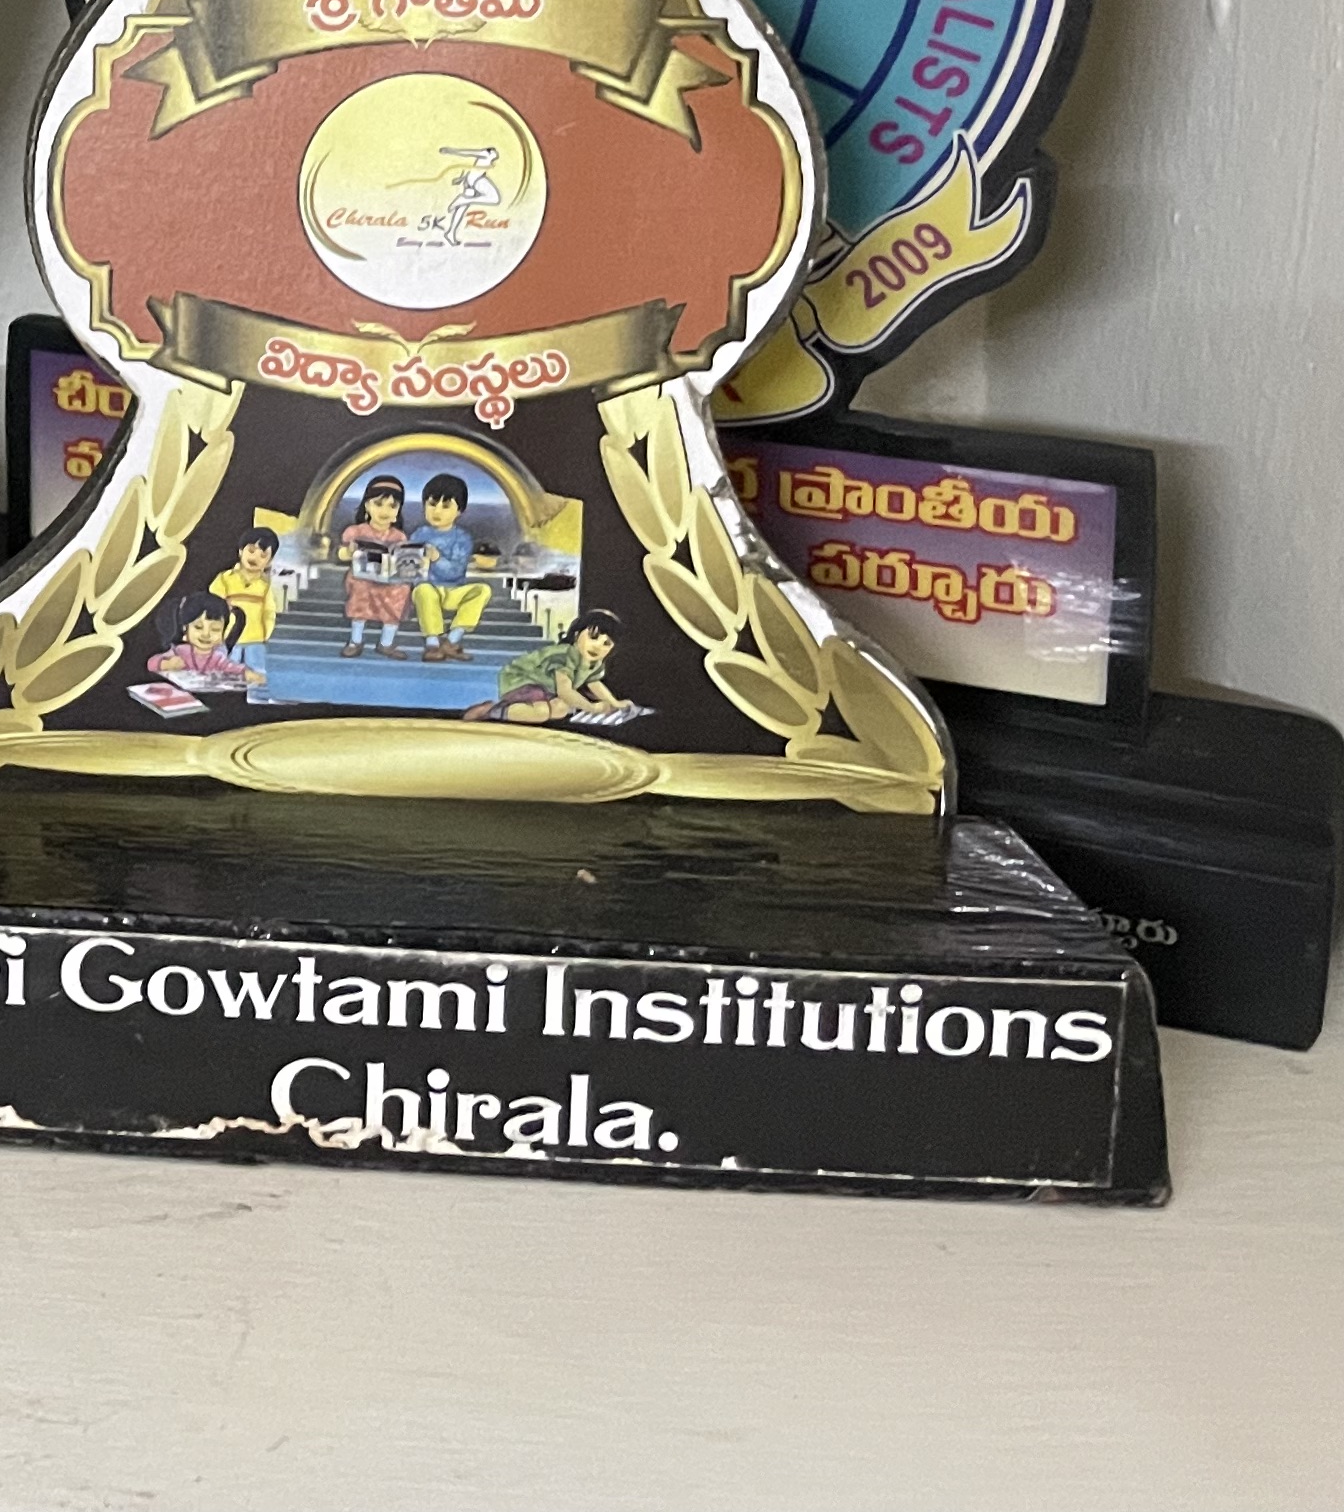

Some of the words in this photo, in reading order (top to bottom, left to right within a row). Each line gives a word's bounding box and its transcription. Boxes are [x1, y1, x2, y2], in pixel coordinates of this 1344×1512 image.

[326, 208, 408, 228] Chirala
[417, 215, 447, 231] 5K
[464, 210, 511, 230] Run
[845, 221, 952, 311] 2009
[257, 336, 384, 414] విద్యా
[389, 345, 569, 429] సంస్థలు
[777, 464, 1078, 544] ప్రాంతీయ
[60, 938, 507, 1038] Gowtami
[540, 962, 1112, 1066] Institutions
[269, 1057, 680, 1153] Chirala.
